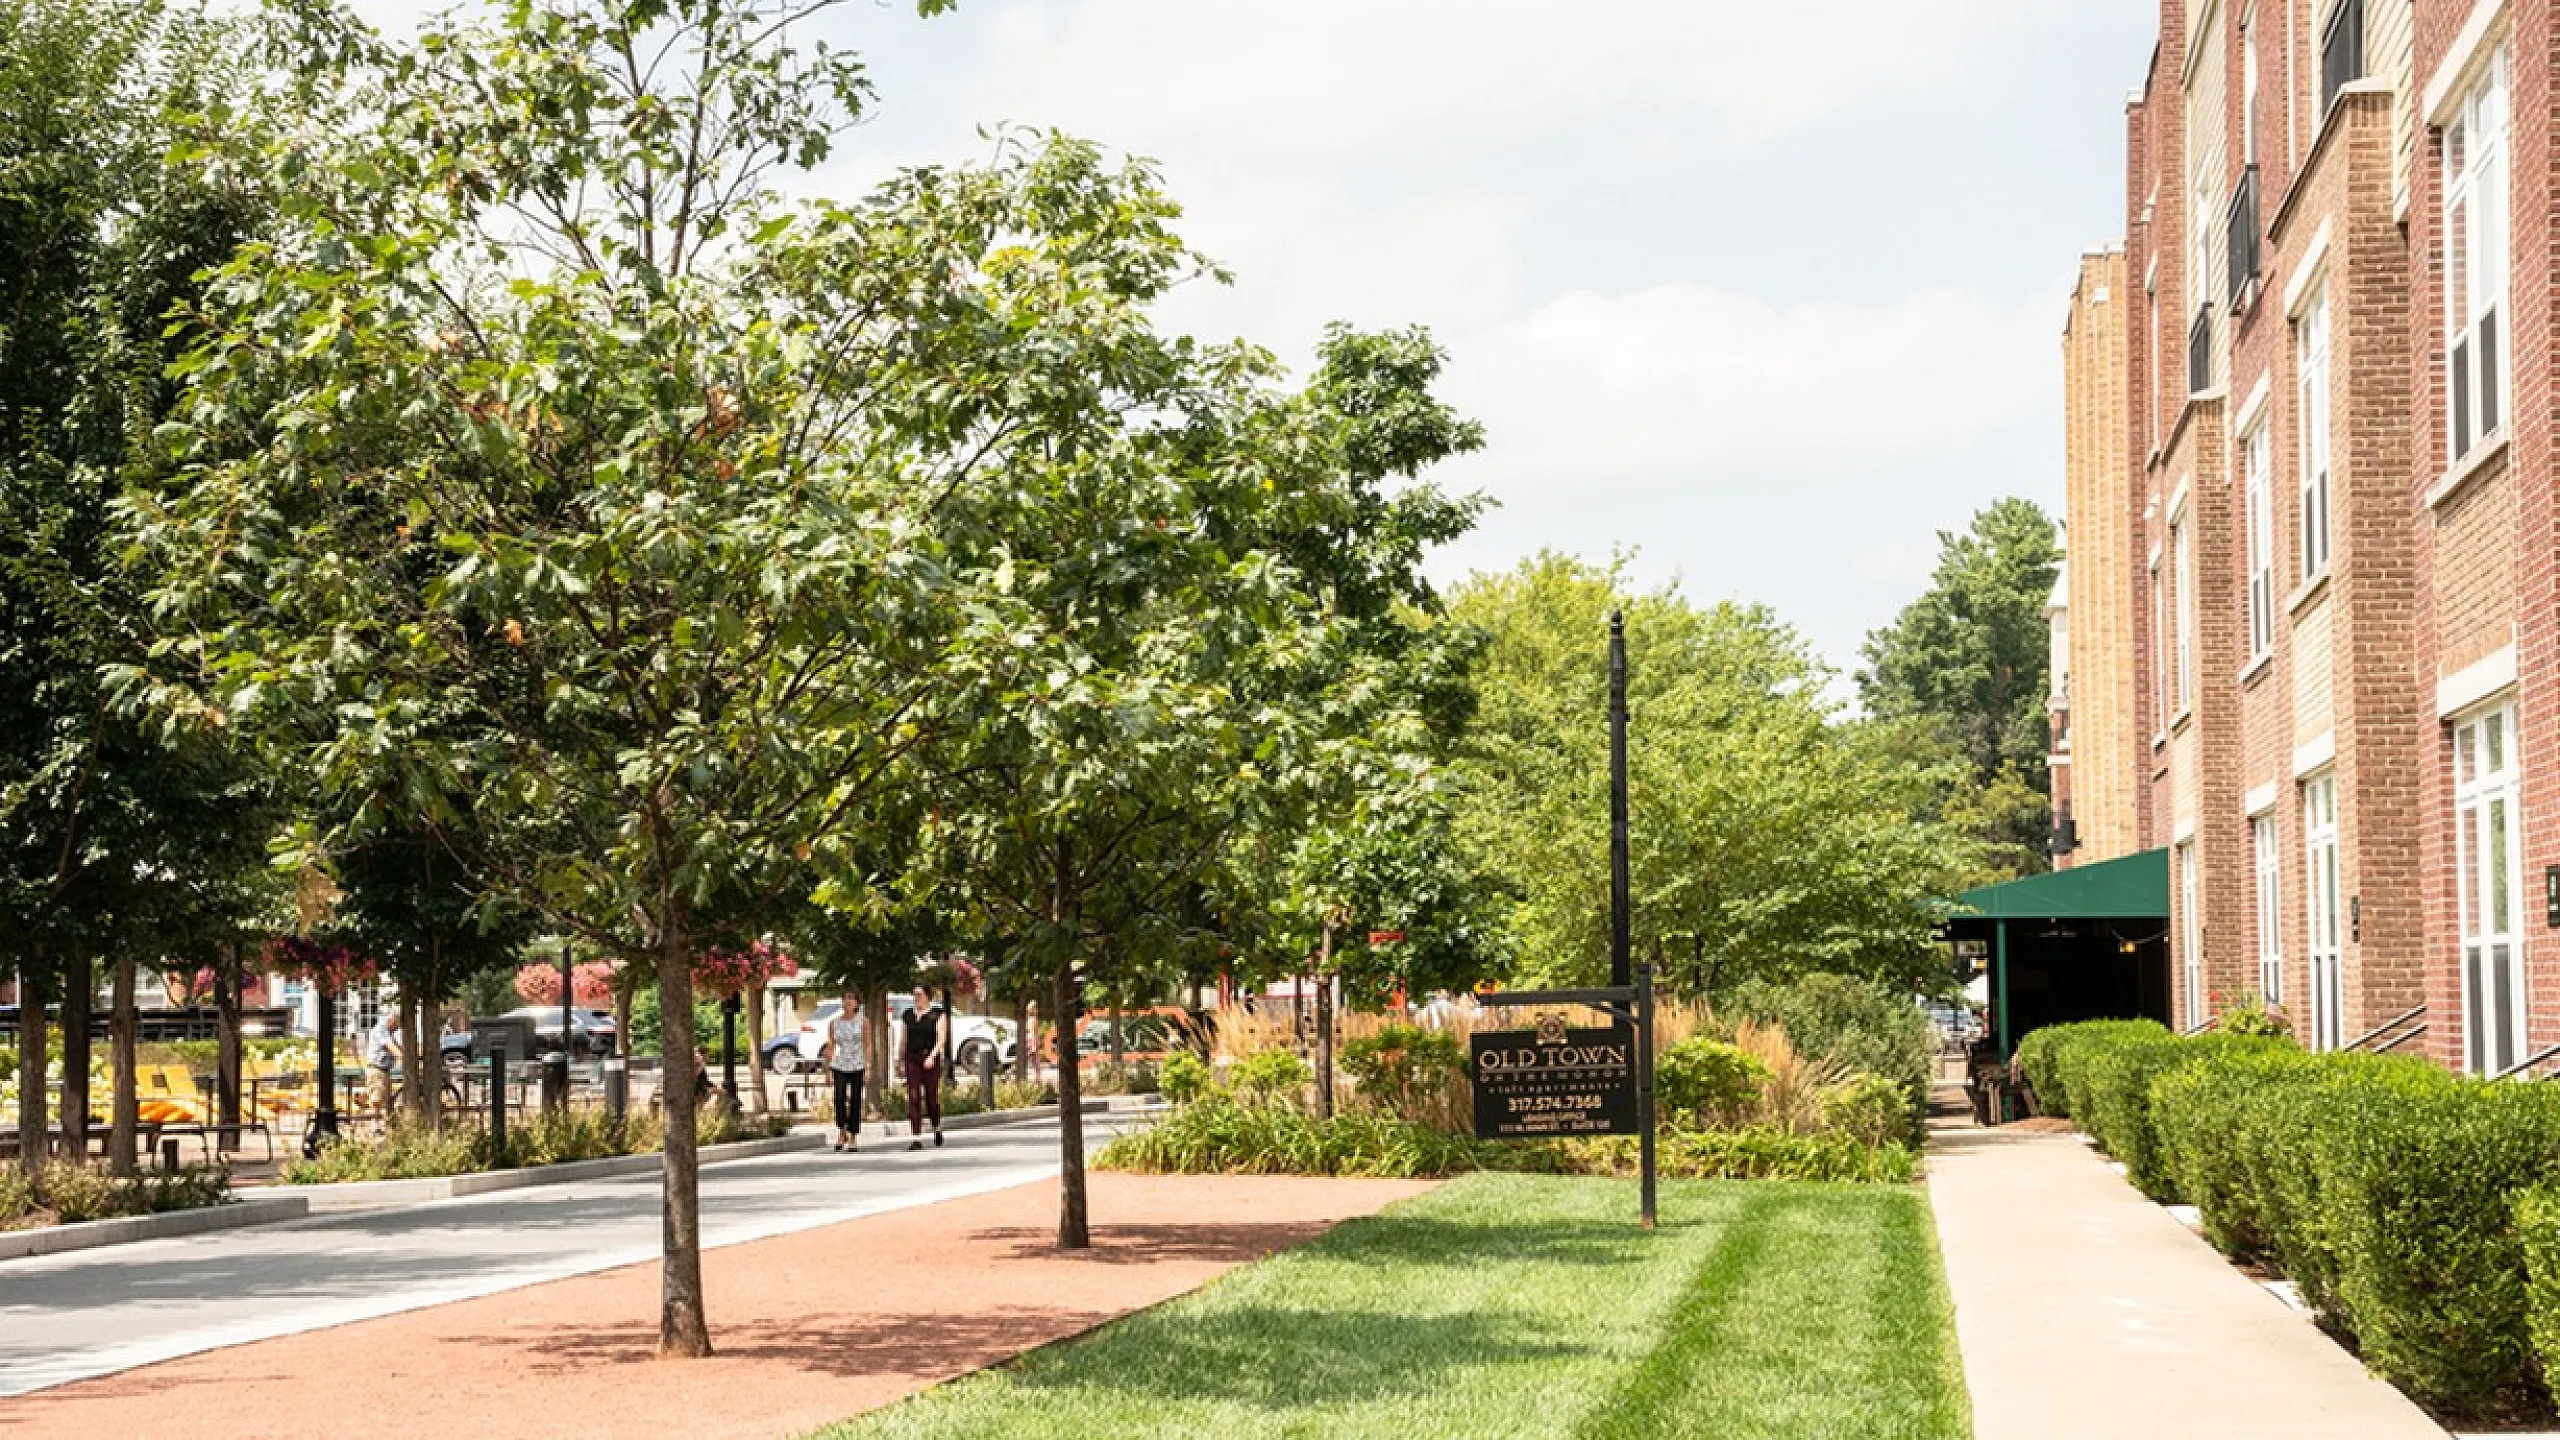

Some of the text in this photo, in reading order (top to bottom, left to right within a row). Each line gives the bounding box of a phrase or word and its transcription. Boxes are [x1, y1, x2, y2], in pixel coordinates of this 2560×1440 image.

[1479, 1045, 1626, 1069] OLD TOWN
[1508, 1094, 1603, 1112] 317.574.7368
